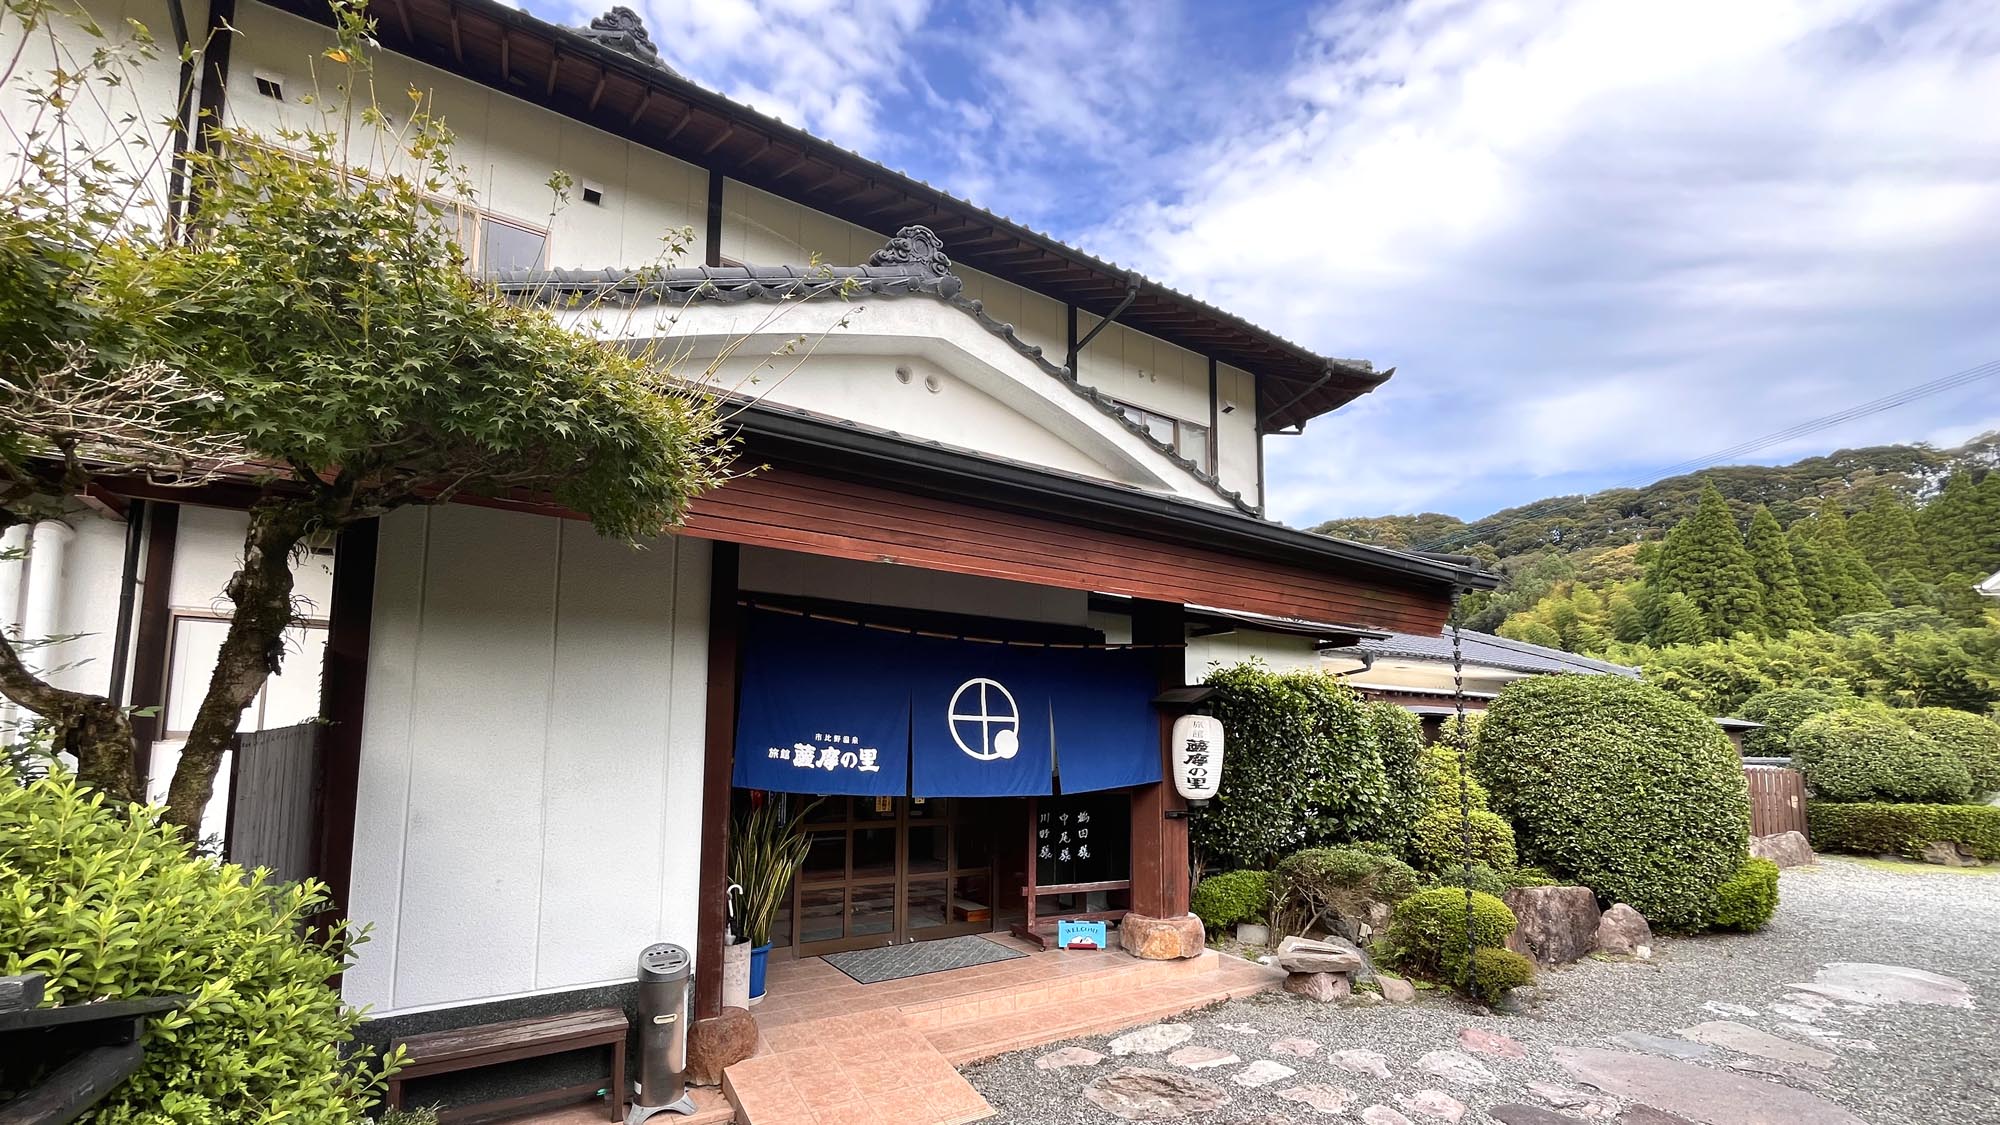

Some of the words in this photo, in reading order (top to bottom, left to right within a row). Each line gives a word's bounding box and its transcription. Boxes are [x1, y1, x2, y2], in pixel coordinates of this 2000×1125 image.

[768, 747, 791, 760] 旅館
[793, 742, 880, 772] 薩摩の里
[1183, 739, 1211, 790] 薩摩の里
[1065, 926, 1099, 935] WELCOME
